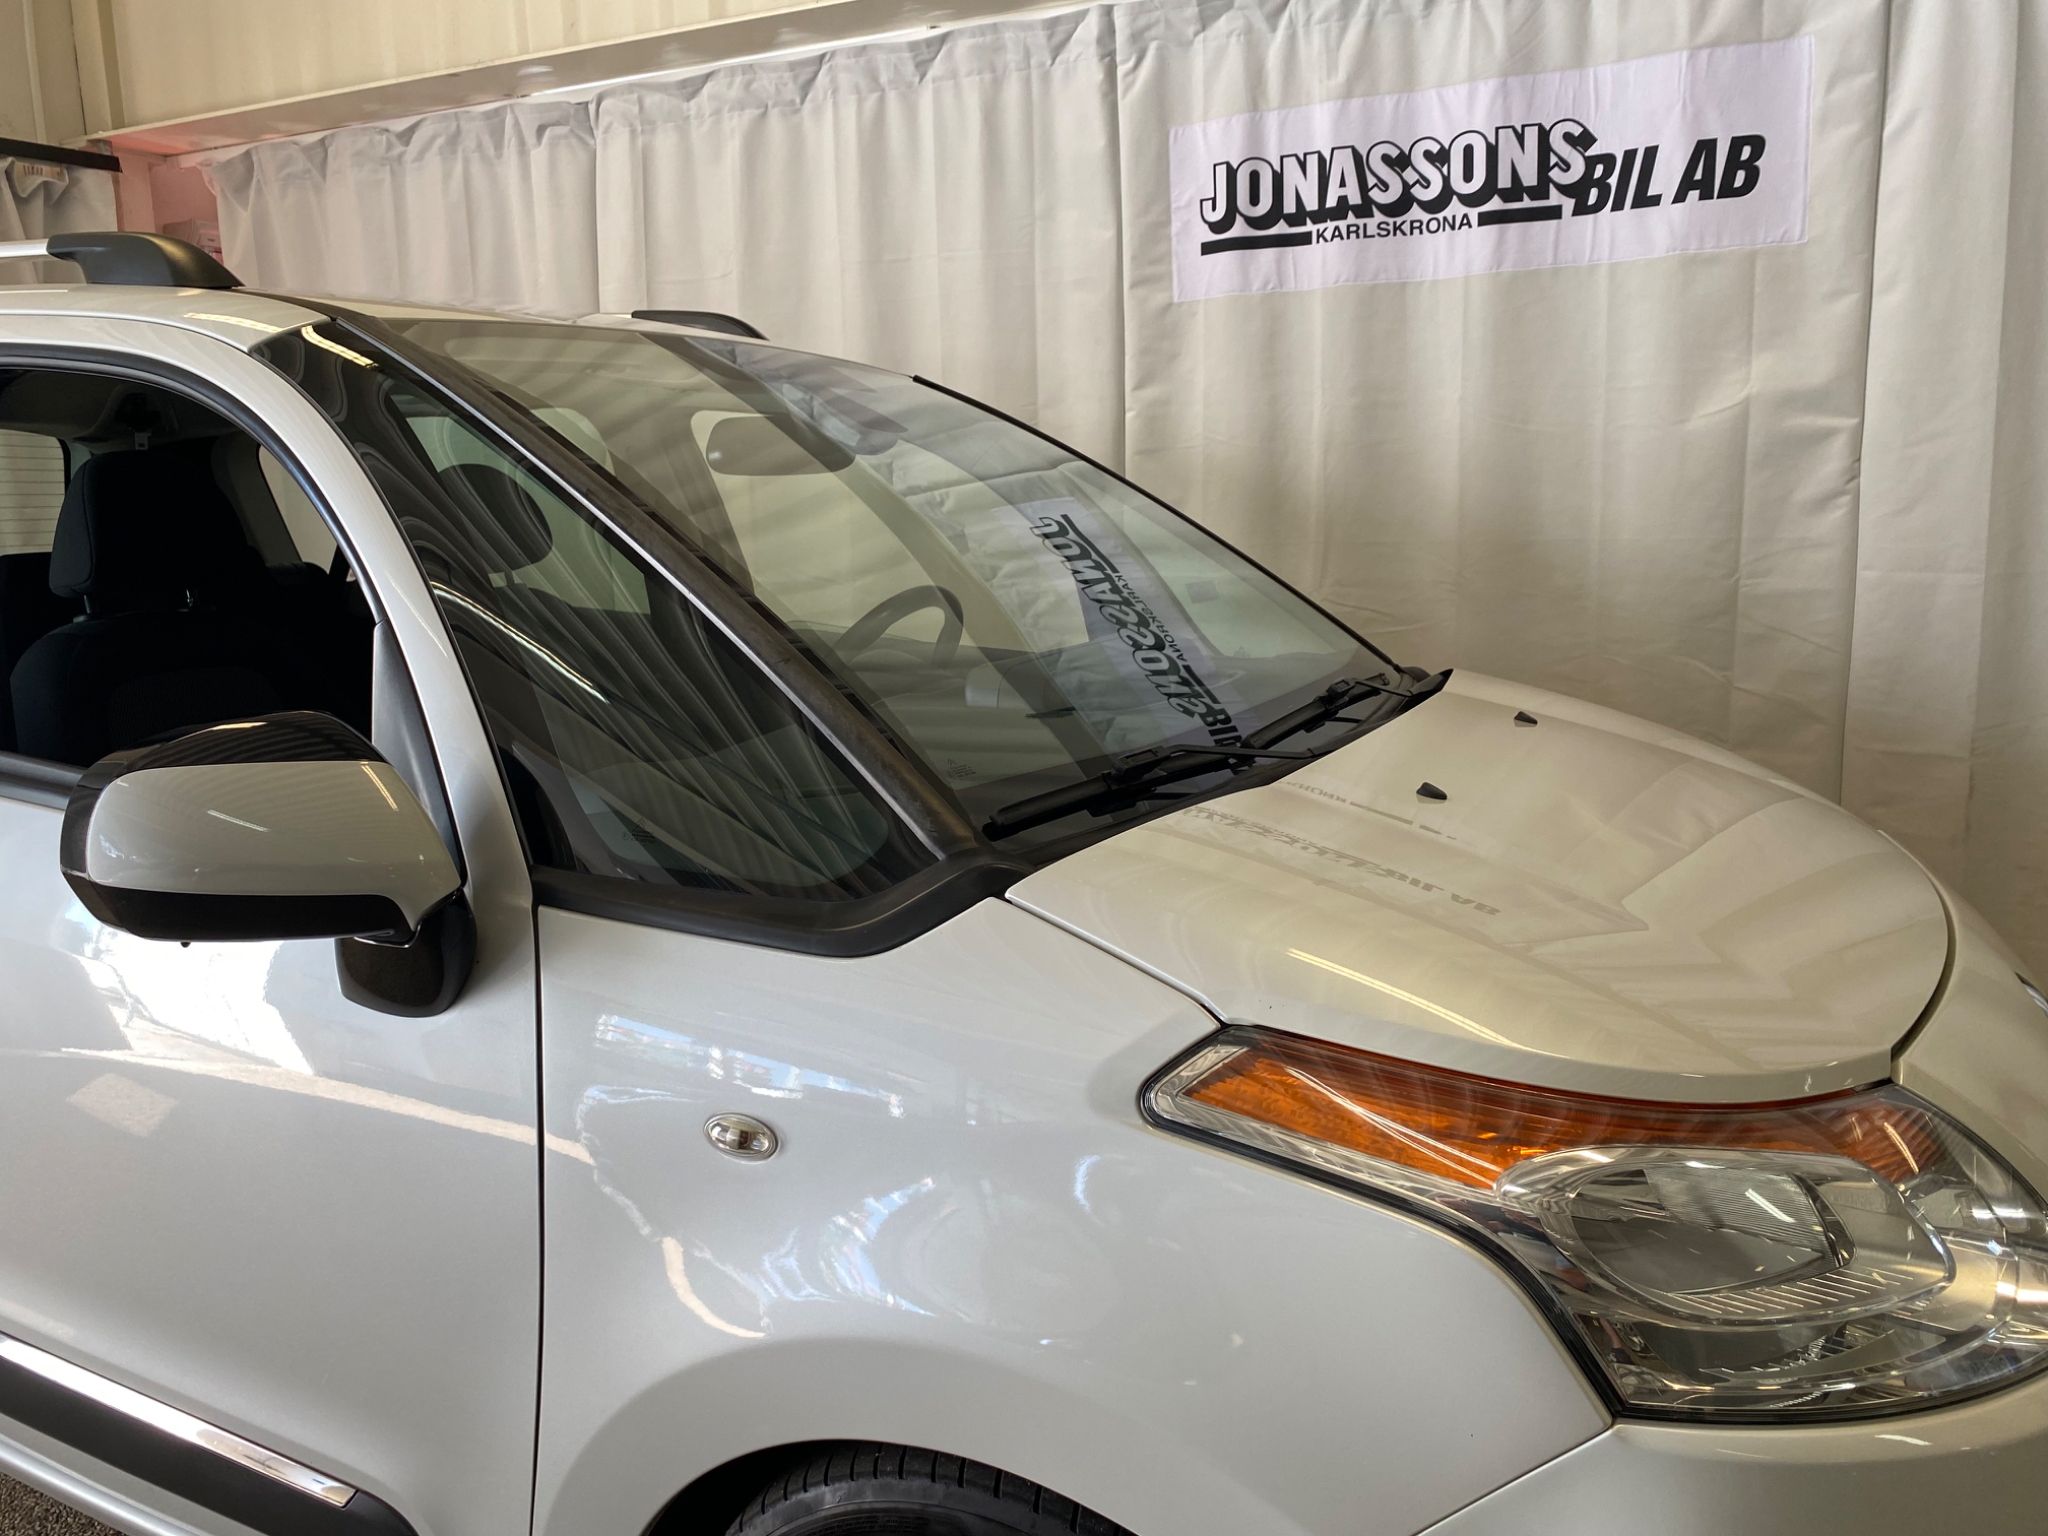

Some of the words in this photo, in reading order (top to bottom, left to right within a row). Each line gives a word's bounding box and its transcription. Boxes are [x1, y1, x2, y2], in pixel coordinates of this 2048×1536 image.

[1200, 119, 1596, 234] JONASSONS
[1572, 144, 1662, 217] BIL
[1672, 134, 1766, 204] AB
[1316, 213, 1473, 244] KARLSKRONA
